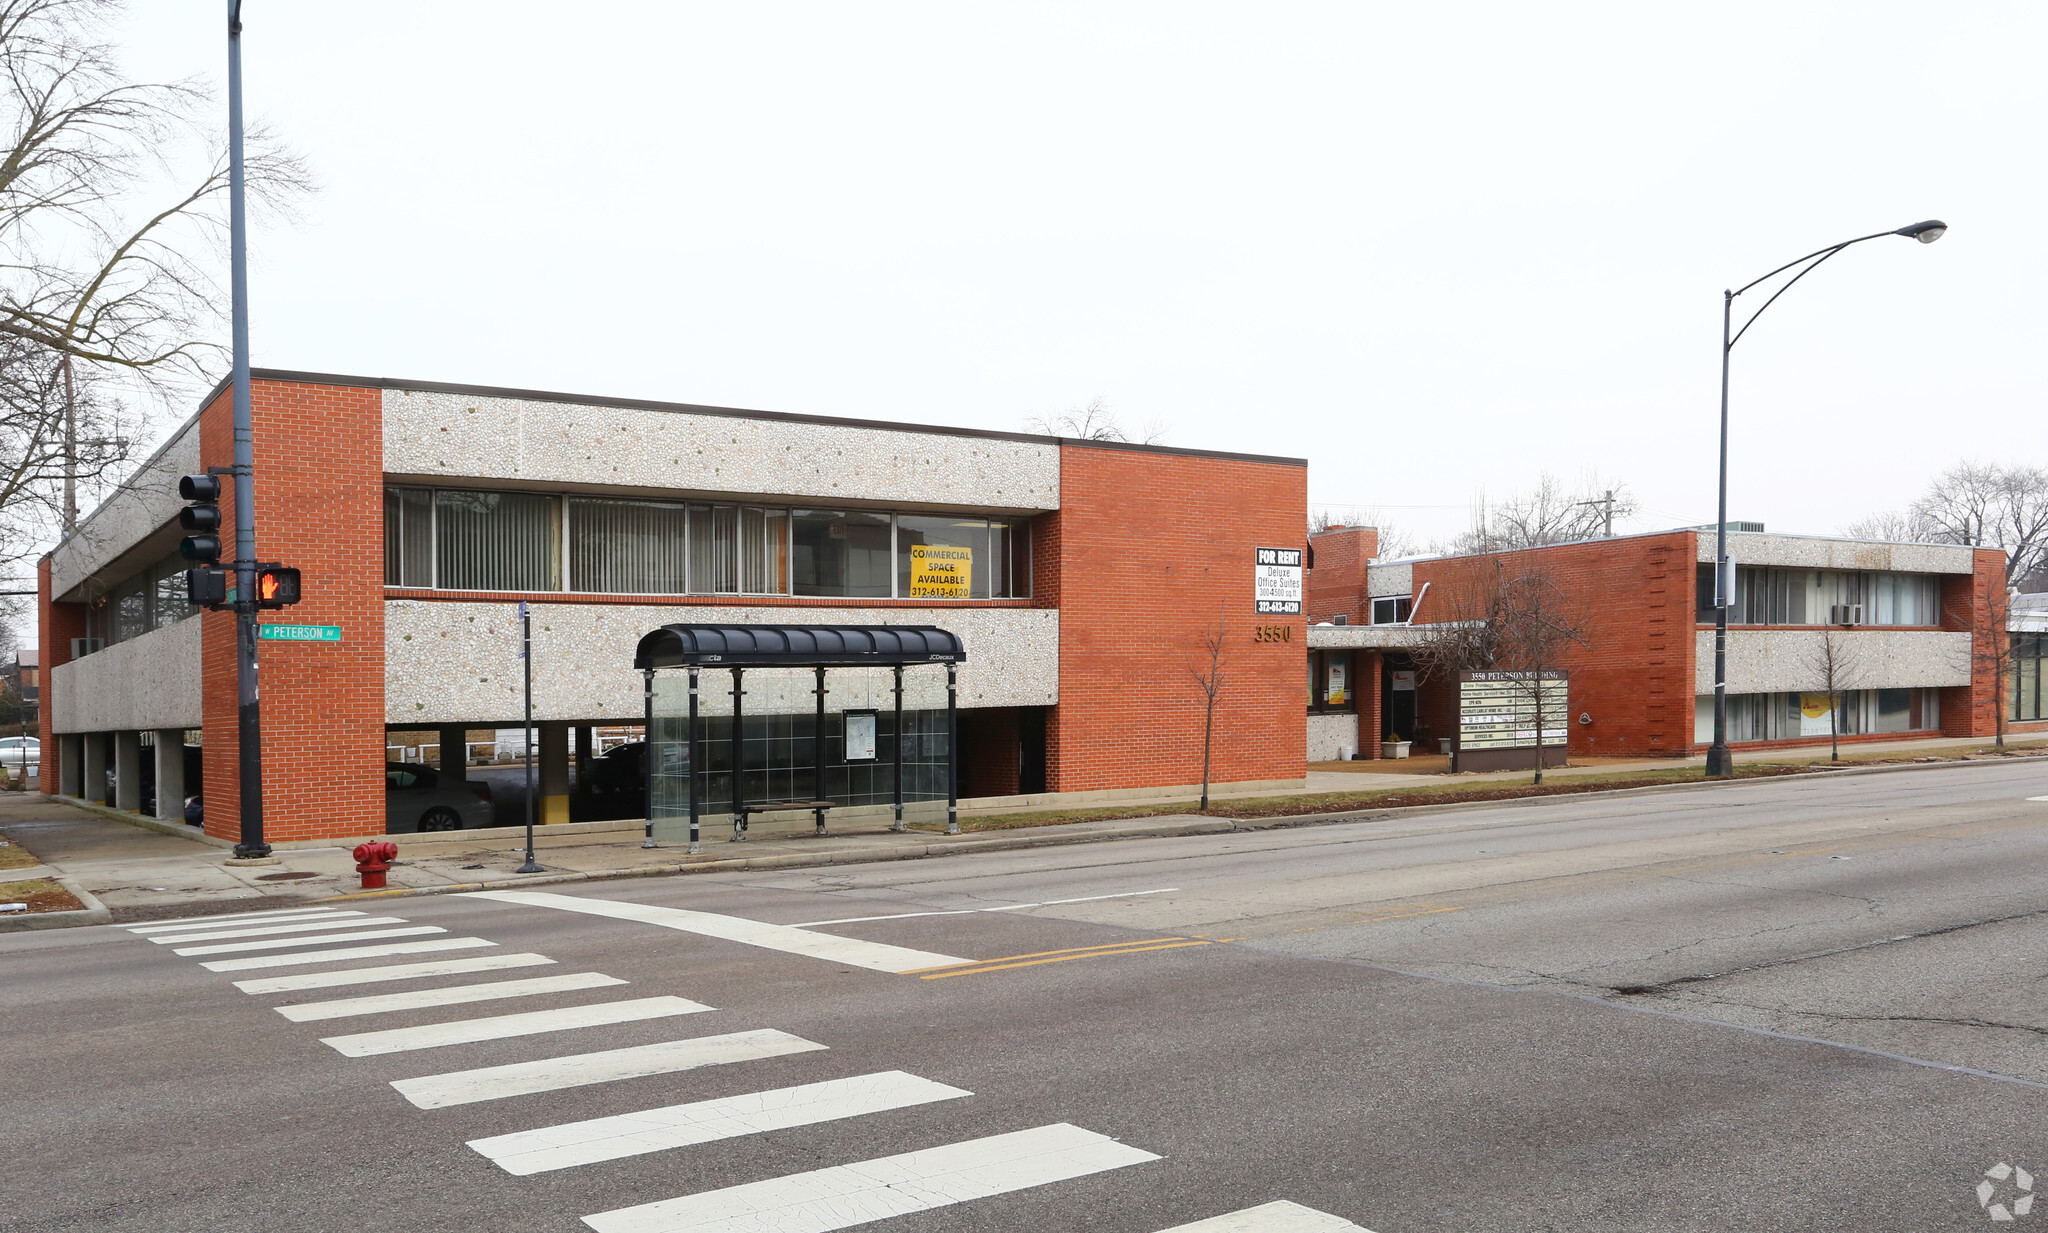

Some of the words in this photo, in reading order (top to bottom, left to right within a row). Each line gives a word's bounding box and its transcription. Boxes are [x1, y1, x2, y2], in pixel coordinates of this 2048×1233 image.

[912, 550, 970, 560] COMMERCIAL
[1258, 550, 1276, 564] FOR
[1277, 551, 1300, 565] RENT
[928, 563, 955, 572] SPACE
[1268, 566, 1290, 577] Deluxe
[918, 575, 964, 584] AVAILABLE
[1258, 576, 1278, 587] Office
[1280, 578, 1300, 588] Suites
[912, 587, 968, 596] 312-613-6120
[1258, 602, 1299, 612] 312-613-6120
[274, 626, 323, 638] PETERSON
[1254, 624, 1292, 642] 3550
